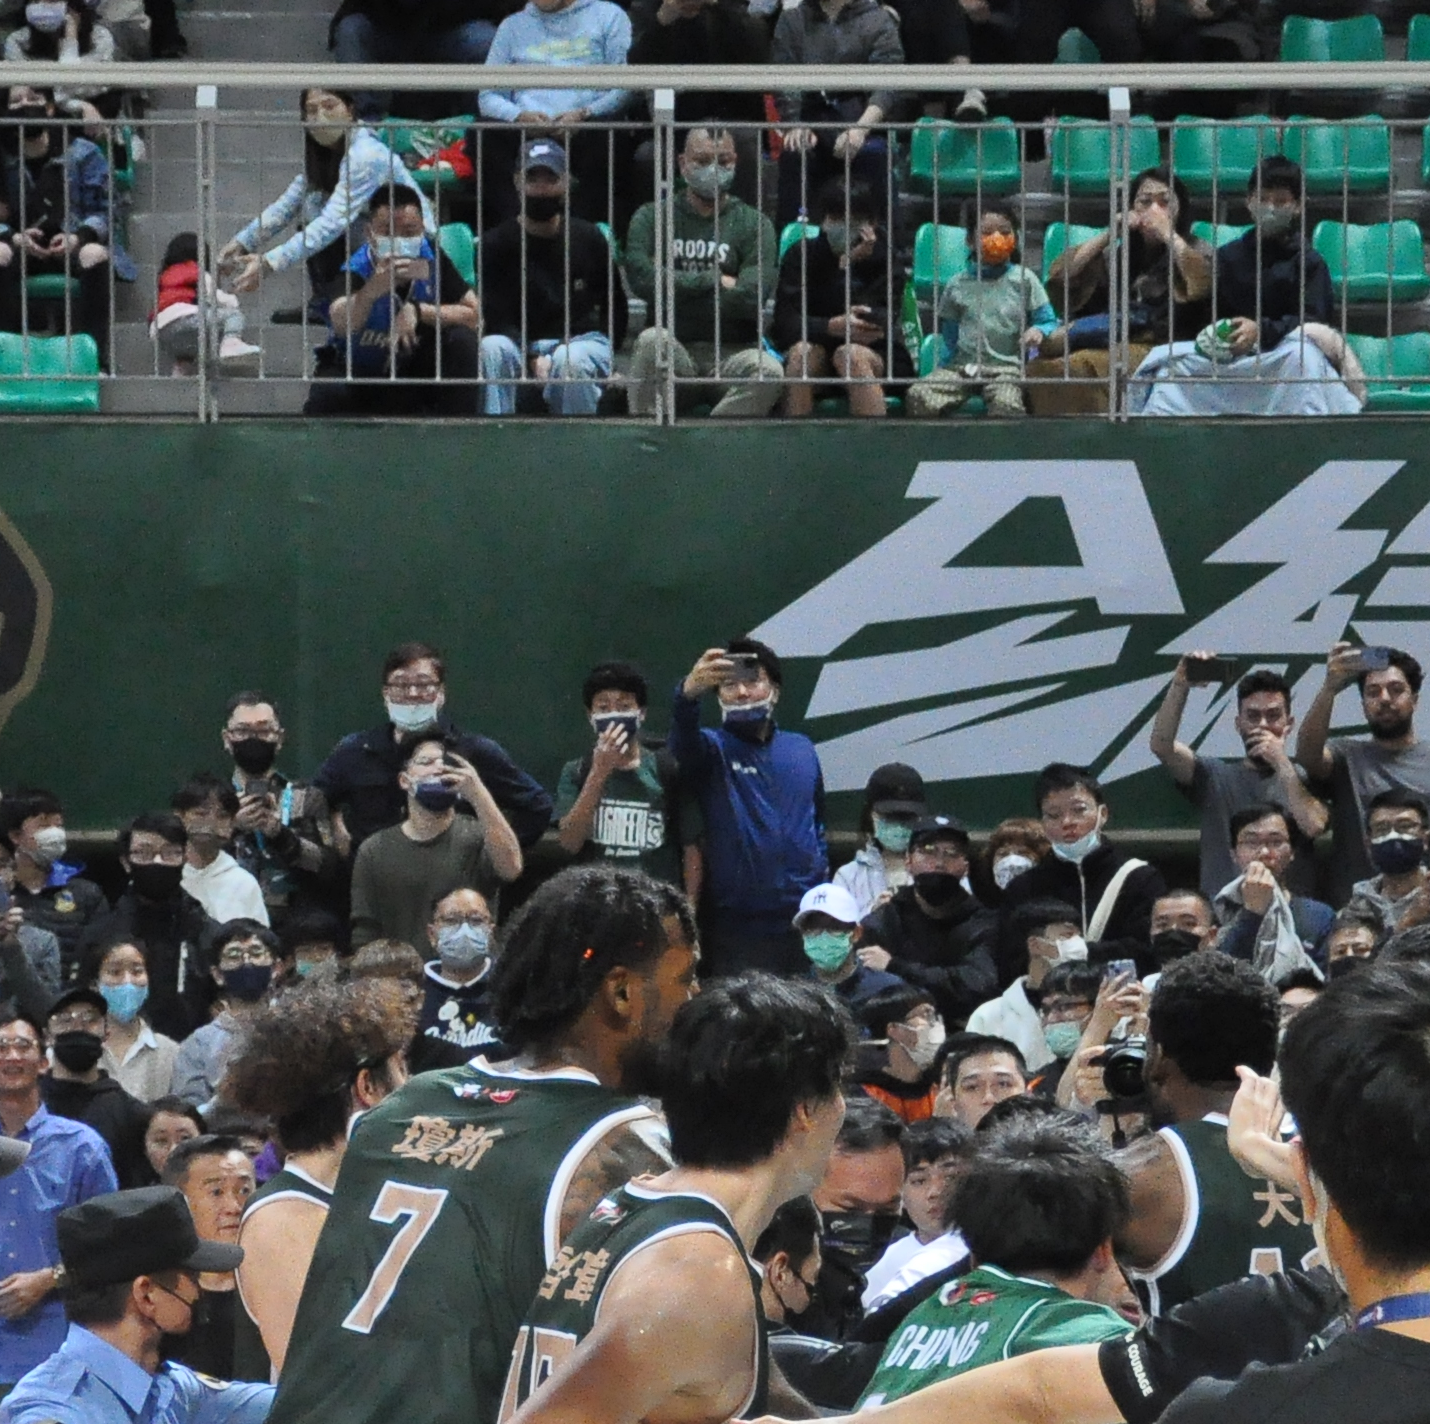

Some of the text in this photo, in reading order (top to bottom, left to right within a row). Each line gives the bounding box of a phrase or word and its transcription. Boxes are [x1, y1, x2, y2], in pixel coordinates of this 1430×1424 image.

[672, 238, 730, 263] ROOTS
[342, 1180, 449, 1334] 7
[885, 1321, 989, 1370] CHIANG
[1127, 1342, 1154, 1398] COURAGE
